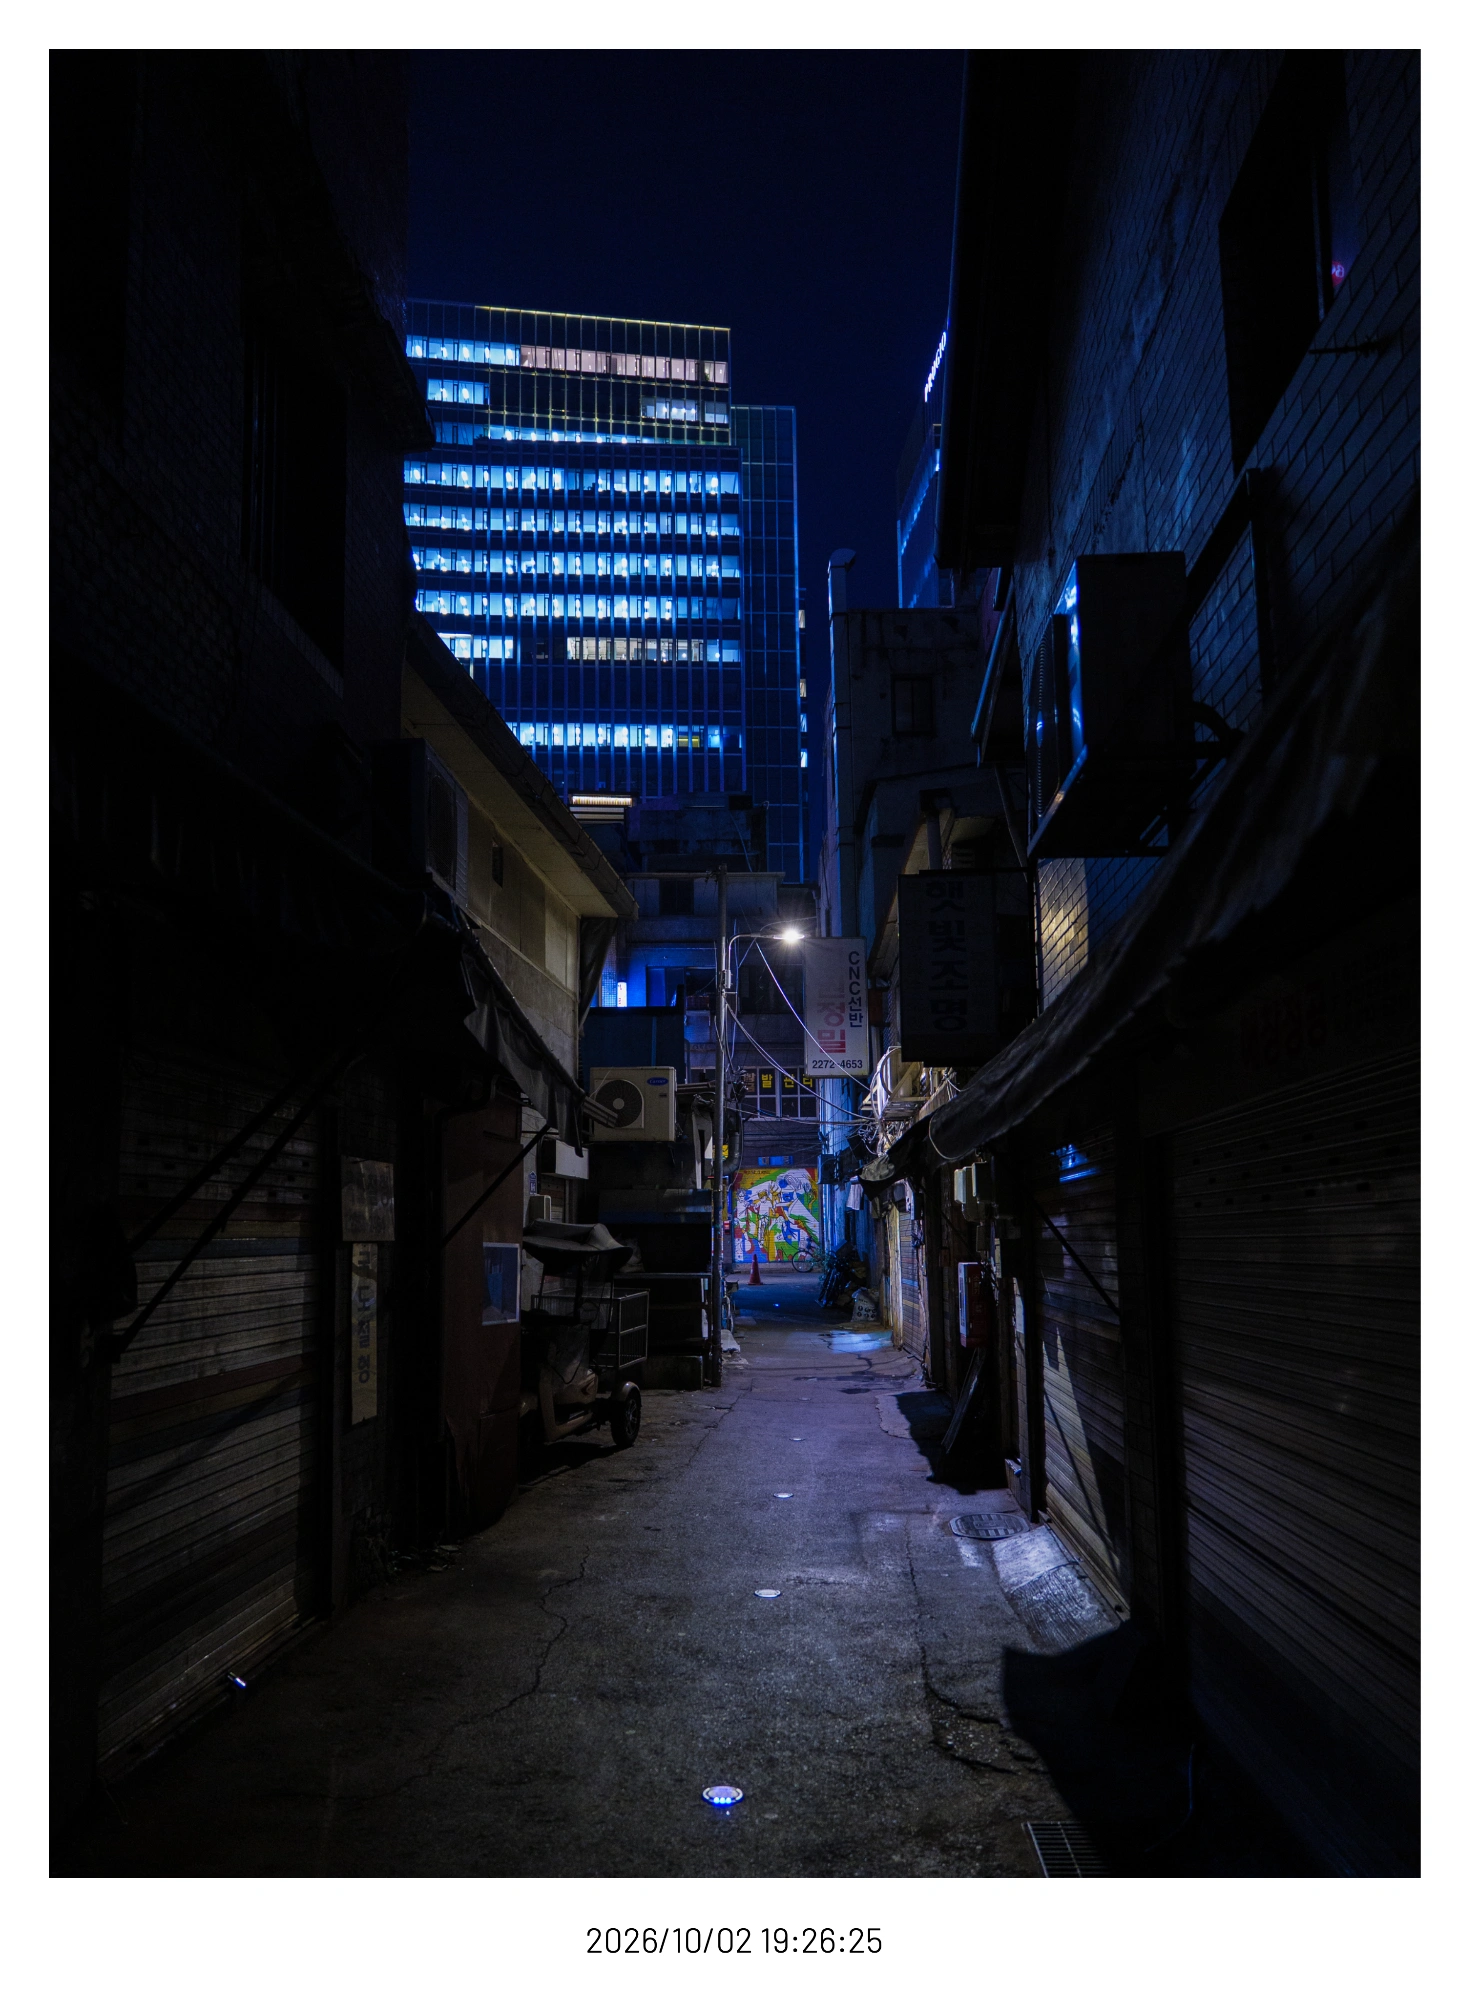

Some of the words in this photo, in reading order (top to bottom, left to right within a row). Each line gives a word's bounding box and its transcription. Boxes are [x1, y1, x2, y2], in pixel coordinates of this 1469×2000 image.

[848, 951, 864, 1028] CNC선반
[926, 880, 970, 1032] 햇빛조명
[812, 1060, 863, 1069] 2272-4653
